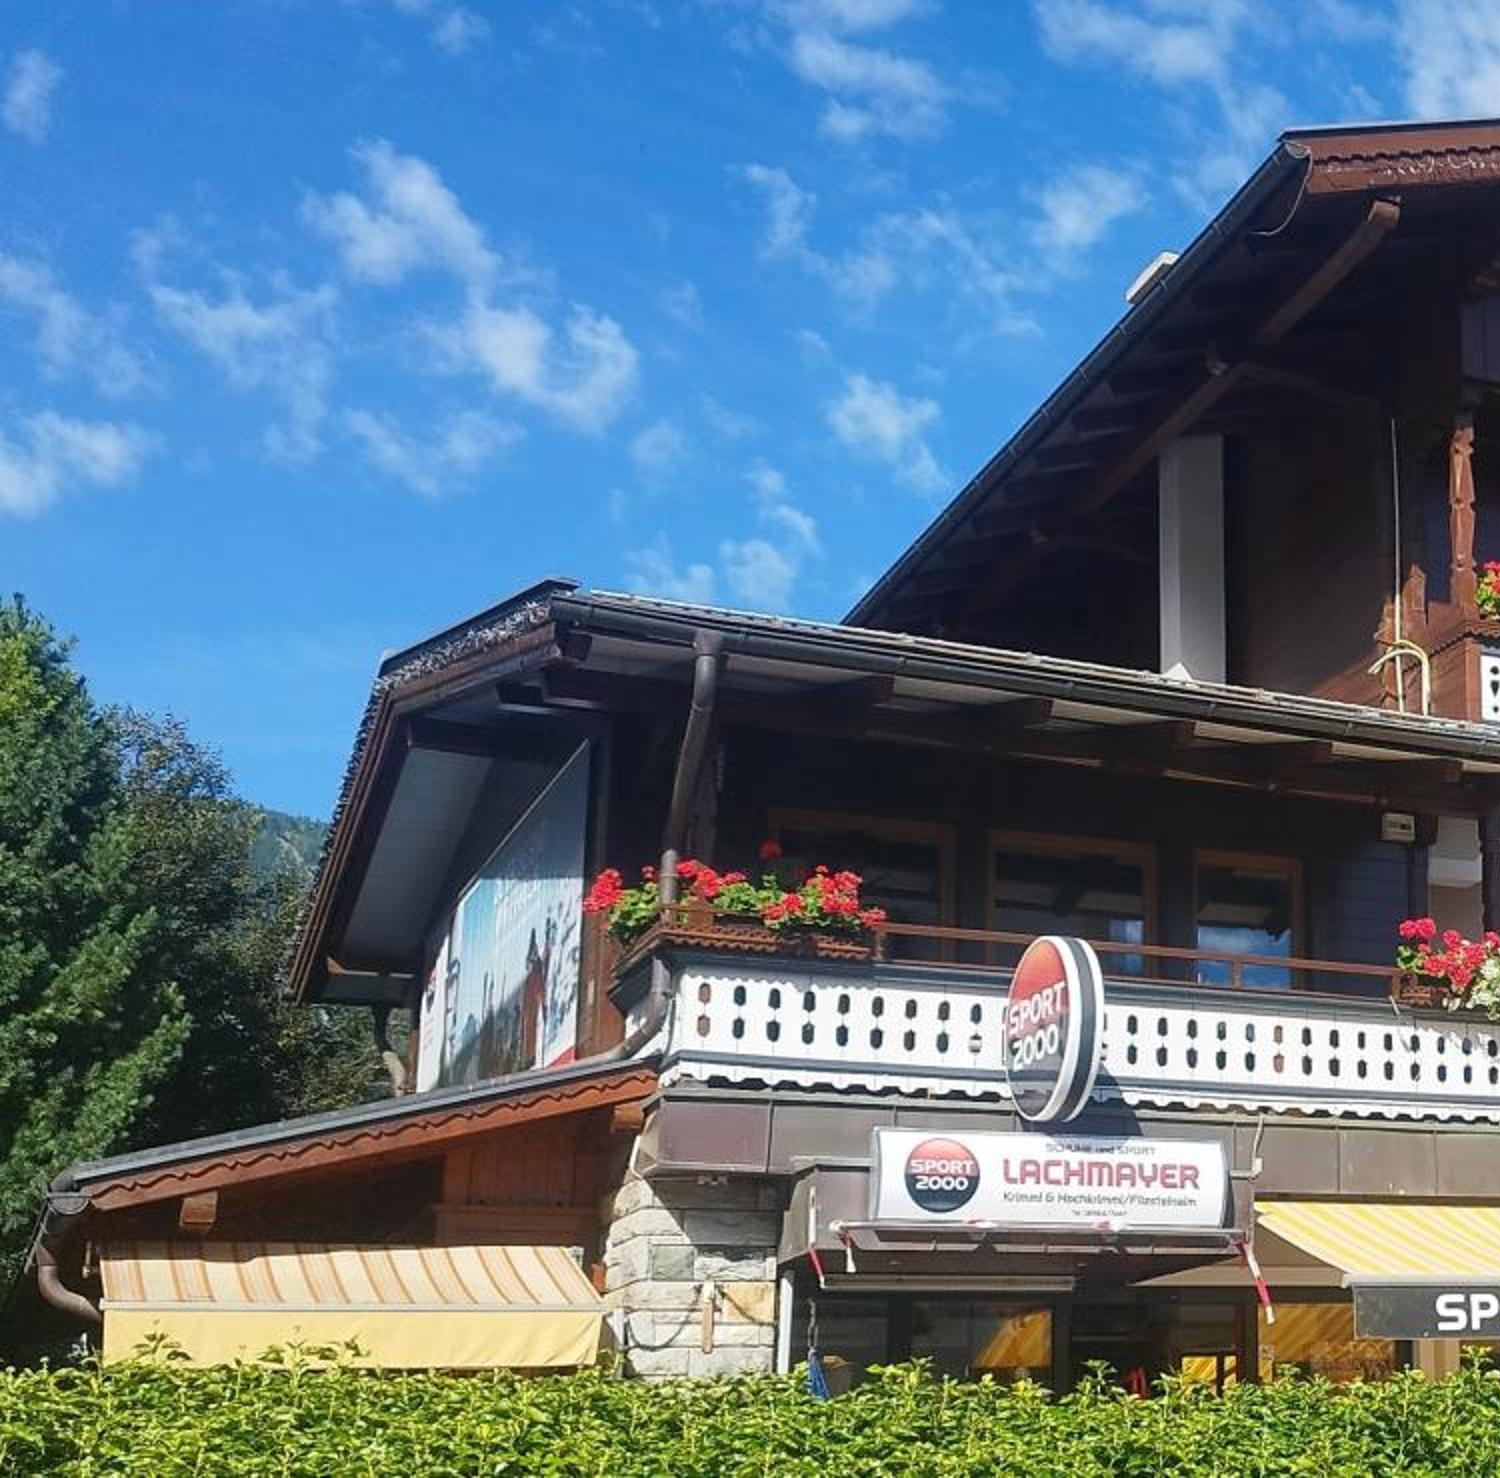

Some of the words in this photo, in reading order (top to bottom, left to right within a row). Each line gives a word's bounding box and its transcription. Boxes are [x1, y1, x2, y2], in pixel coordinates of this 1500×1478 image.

[1009, 981, 1066, 1036] SPORT
[1013, 1023, 1058, 1072] 2000
[1118, 1145, 1156, 1156] SPORT
[910, 1159, 976, 1176] SPORT
[1003, 1158, 1201, 1190] LACHMAYER
[915, 1175, 969, 1191] 2000
[1045, 1192, 1055, 1203] &
